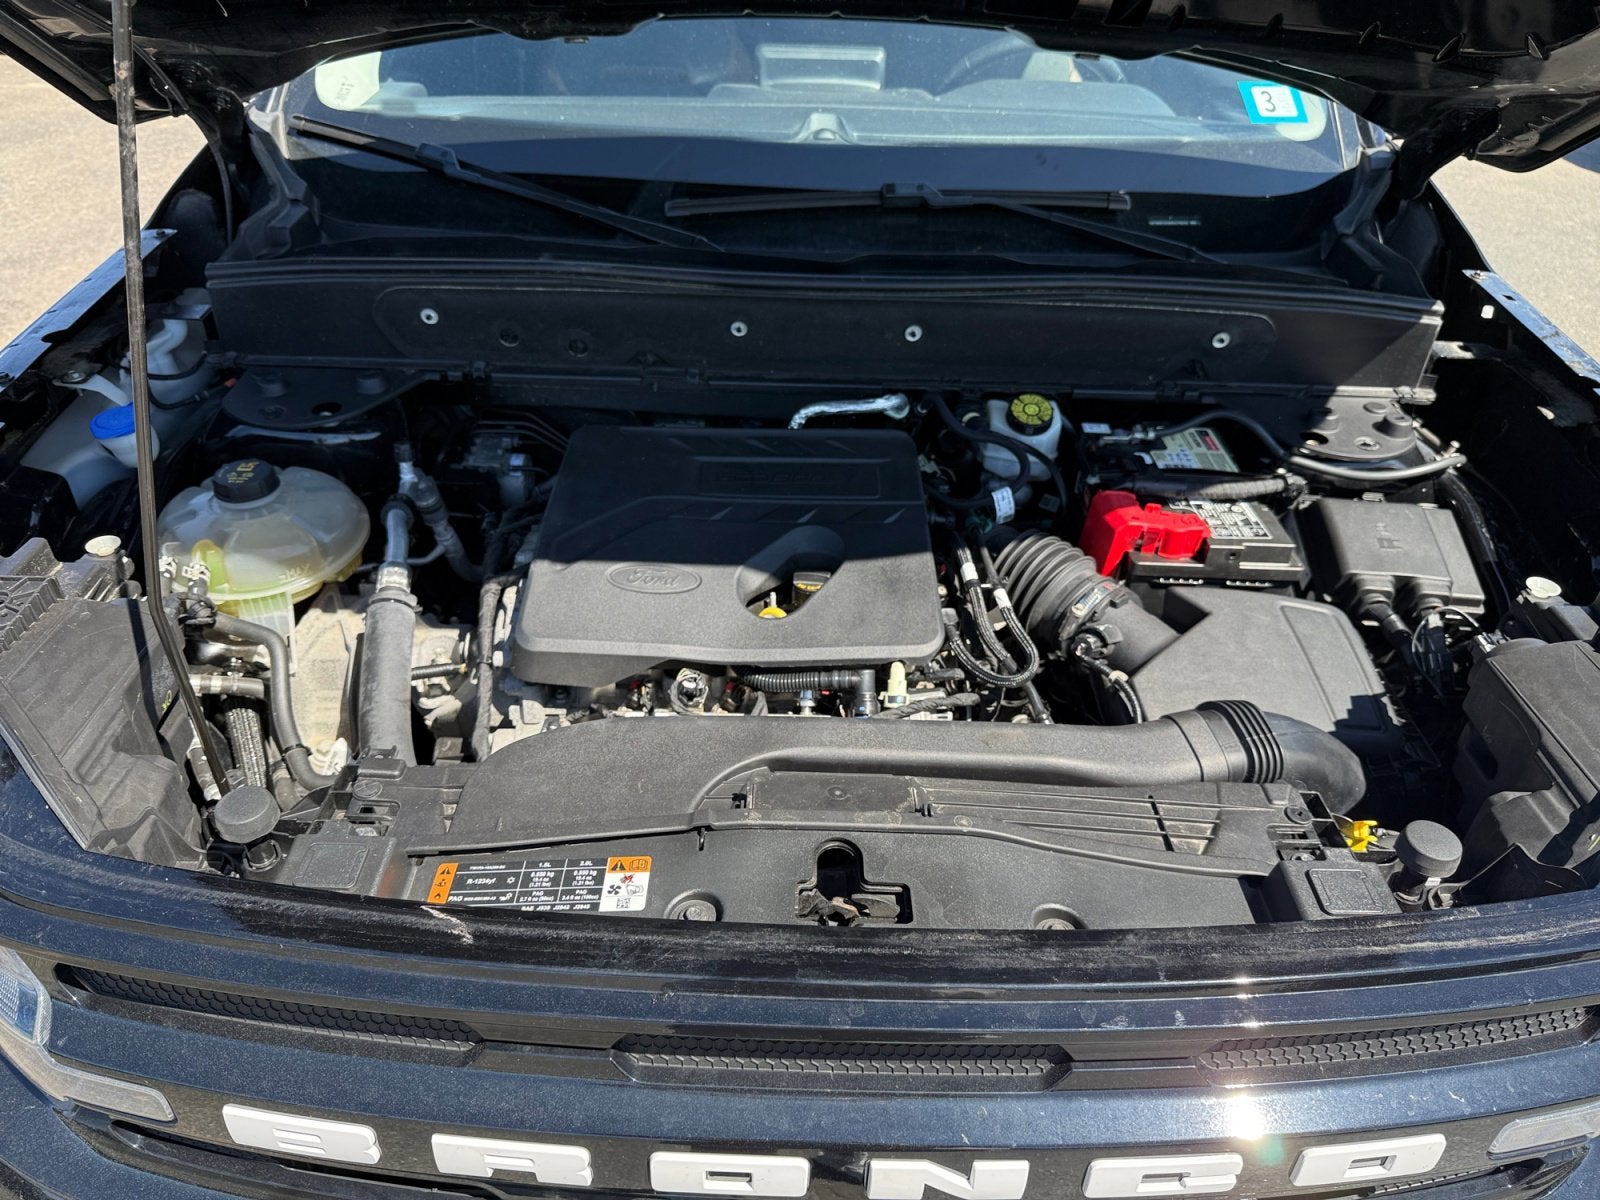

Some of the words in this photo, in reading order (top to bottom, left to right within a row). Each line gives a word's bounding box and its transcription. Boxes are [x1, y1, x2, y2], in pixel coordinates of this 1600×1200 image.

[1260, 90, 1277, 113] 3
[287, 563, 311, 581] MAX
[627, 568, 681, 587] Ford
[466, 877, 497, 885] R-1234yf
[222, 1103, 1447, 1200] BRONCO
